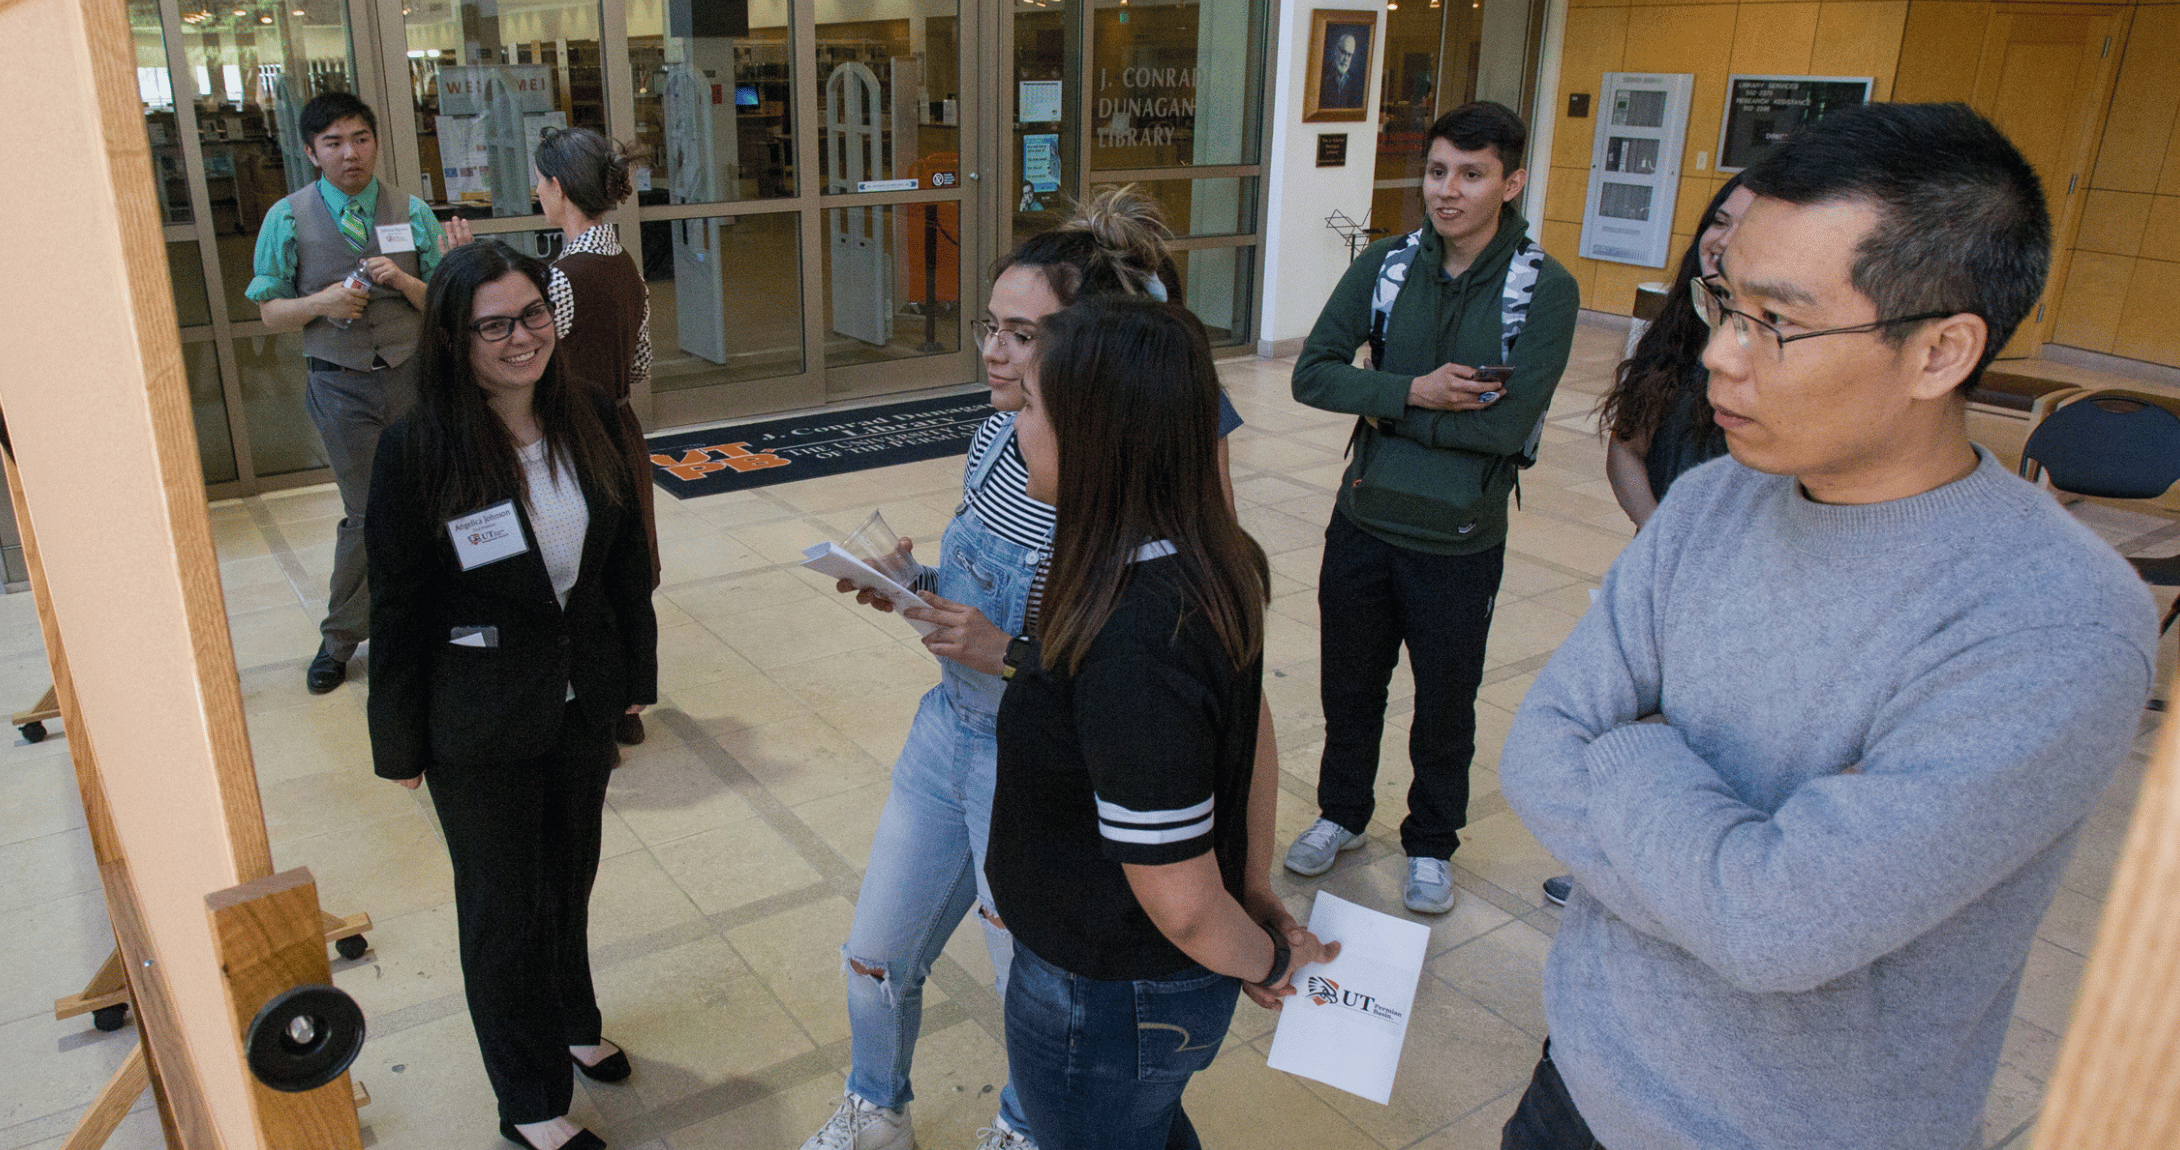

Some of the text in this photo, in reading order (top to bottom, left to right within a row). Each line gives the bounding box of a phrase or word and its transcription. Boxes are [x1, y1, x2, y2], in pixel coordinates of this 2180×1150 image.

[1099, 67, 1205, 91] J. CONRAD
[1098, 98, 1195, 118] DUNAGAN
[1098, 127, 1175, 148] LIBRARY
[762, 432, 786, 442] J.
[790, 416, 889, 437] Conrad
[841, 416, 956, 437] Library
[783, 443, 830, 457] THE
[833, 427, 954, 451] UNIVERSITY
[815, 450, 843, 460] OF
[848, 444, 885, 455] THE
[455, 509, 511, 532] Angelica Johnson
[481, 530, 495, 540] UT
[1342, 989, 1375, 1012] UT
[1374, 1003, 1402, 1018] Permian
